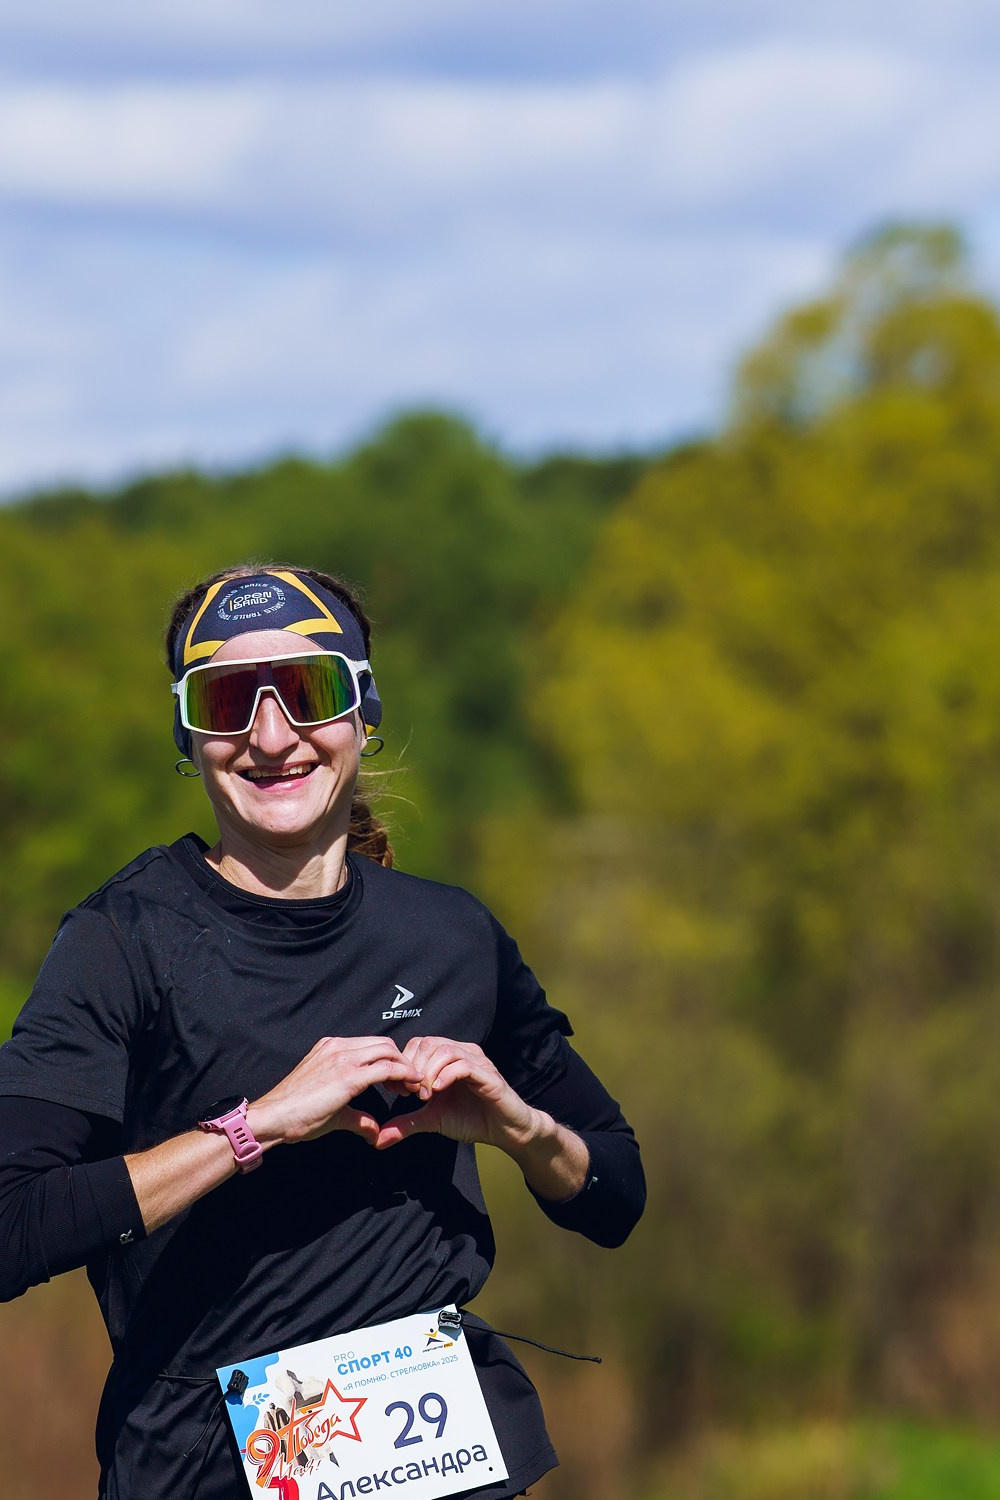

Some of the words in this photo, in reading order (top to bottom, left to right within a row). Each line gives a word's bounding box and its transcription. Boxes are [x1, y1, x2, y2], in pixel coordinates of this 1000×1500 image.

[233, 591, 272, 604] OPEN
[233, 597, 269, 610] BAND
[381, 1008, 423, 1020] DEMIX
[333, 1350, 355, 1363] PRO
[337, 1350, 391, 1376] СПОРТ
[394, 1345, 413, 1360] 40
[441, 1354, 459, 1366] 2025
[384, 1391, 448, 1450] 29
[277, 1397, 342, 1464] Победа
[246, 1428, 281, 1488] 9
